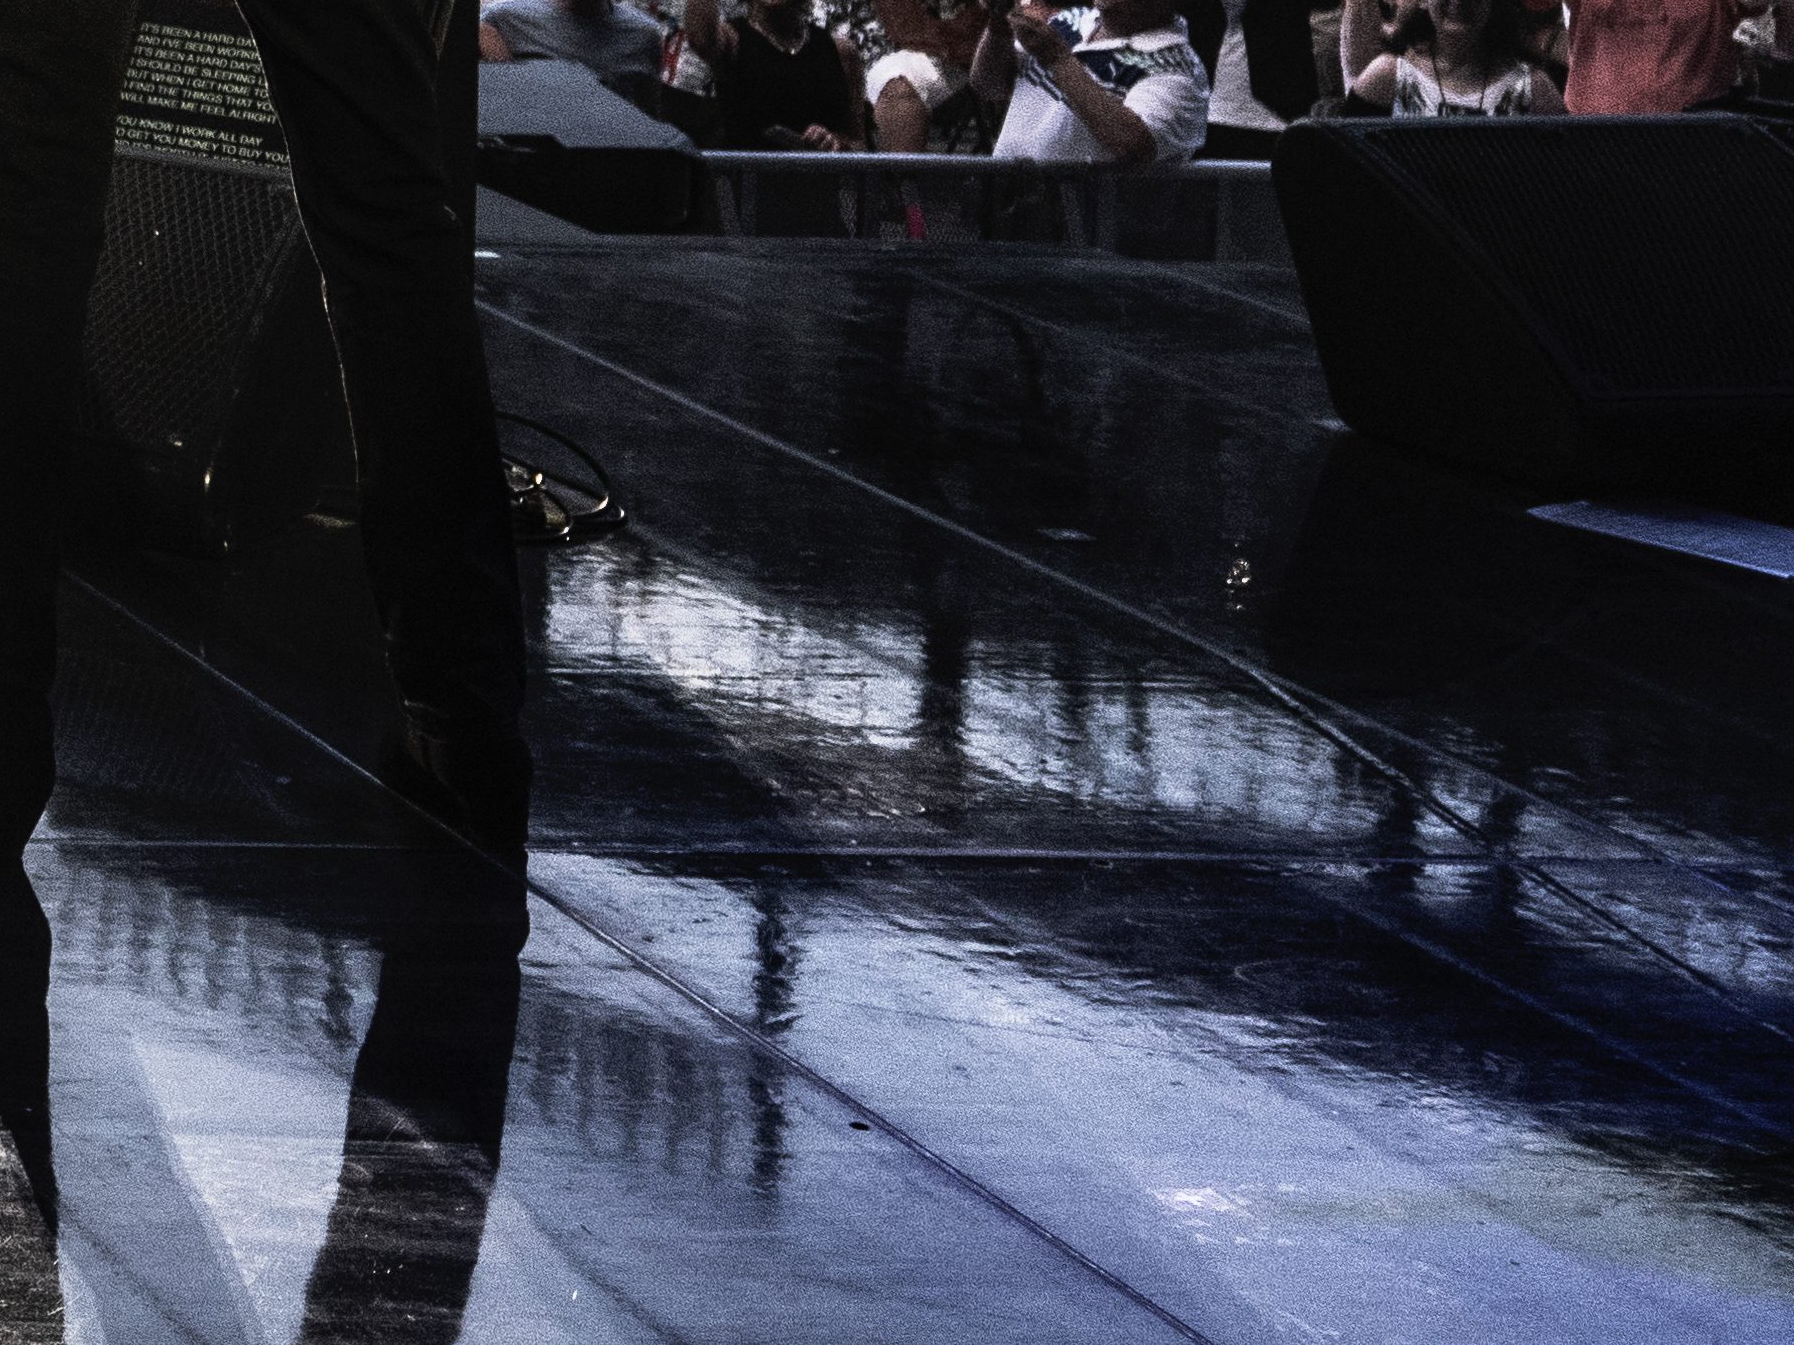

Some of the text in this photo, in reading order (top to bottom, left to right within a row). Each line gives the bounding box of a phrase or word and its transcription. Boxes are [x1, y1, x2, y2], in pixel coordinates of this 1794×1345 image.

[137, 35, 160, 45] AND
[162, 38, 182, 49] I'VE
[185, 42, 215, 54] BEEN
[140, 22, 255, 47] IT'S BEEN A HARD DA
[134, 46, 262, 73] IT'S BEEN A HARD DAY'S
[136, 59, 181, 72] SHOULD
[183, 67, 199, 76] BE
[201, 68, 256, 85] SLEEPING
[126, 69, 149, 80] BUT
[151, 72, 184, 85] WHEN
[192, 79, 216, 90] GET
[217, 84, 251, 95] HOME
[255, 89, 268, 98] TO
[129, 81, 155, 92] FIND
[157, 85, 179, 95] THE
[182, 89, 223, 103] THINGS
[225, 96, 252, 108] THAT
[120, 92, 277, 125] WILL MAKE ME FEEL ALRIGHT
[127, 129, 149, 140] GET
[152, 133, 176, 145] YOU
[178, 138, 219, 152] MONEY
[222, 144, 236, 155] TO
[238, 147, 262, 158] BUY
[265, 152, 290, 163] YOU
[139, 119, 173, 132] KNOW
[181, 126, 216, 139] WORK
[218, 132, 237, 143] ALL
[239, 136, 263, 147] DAY
